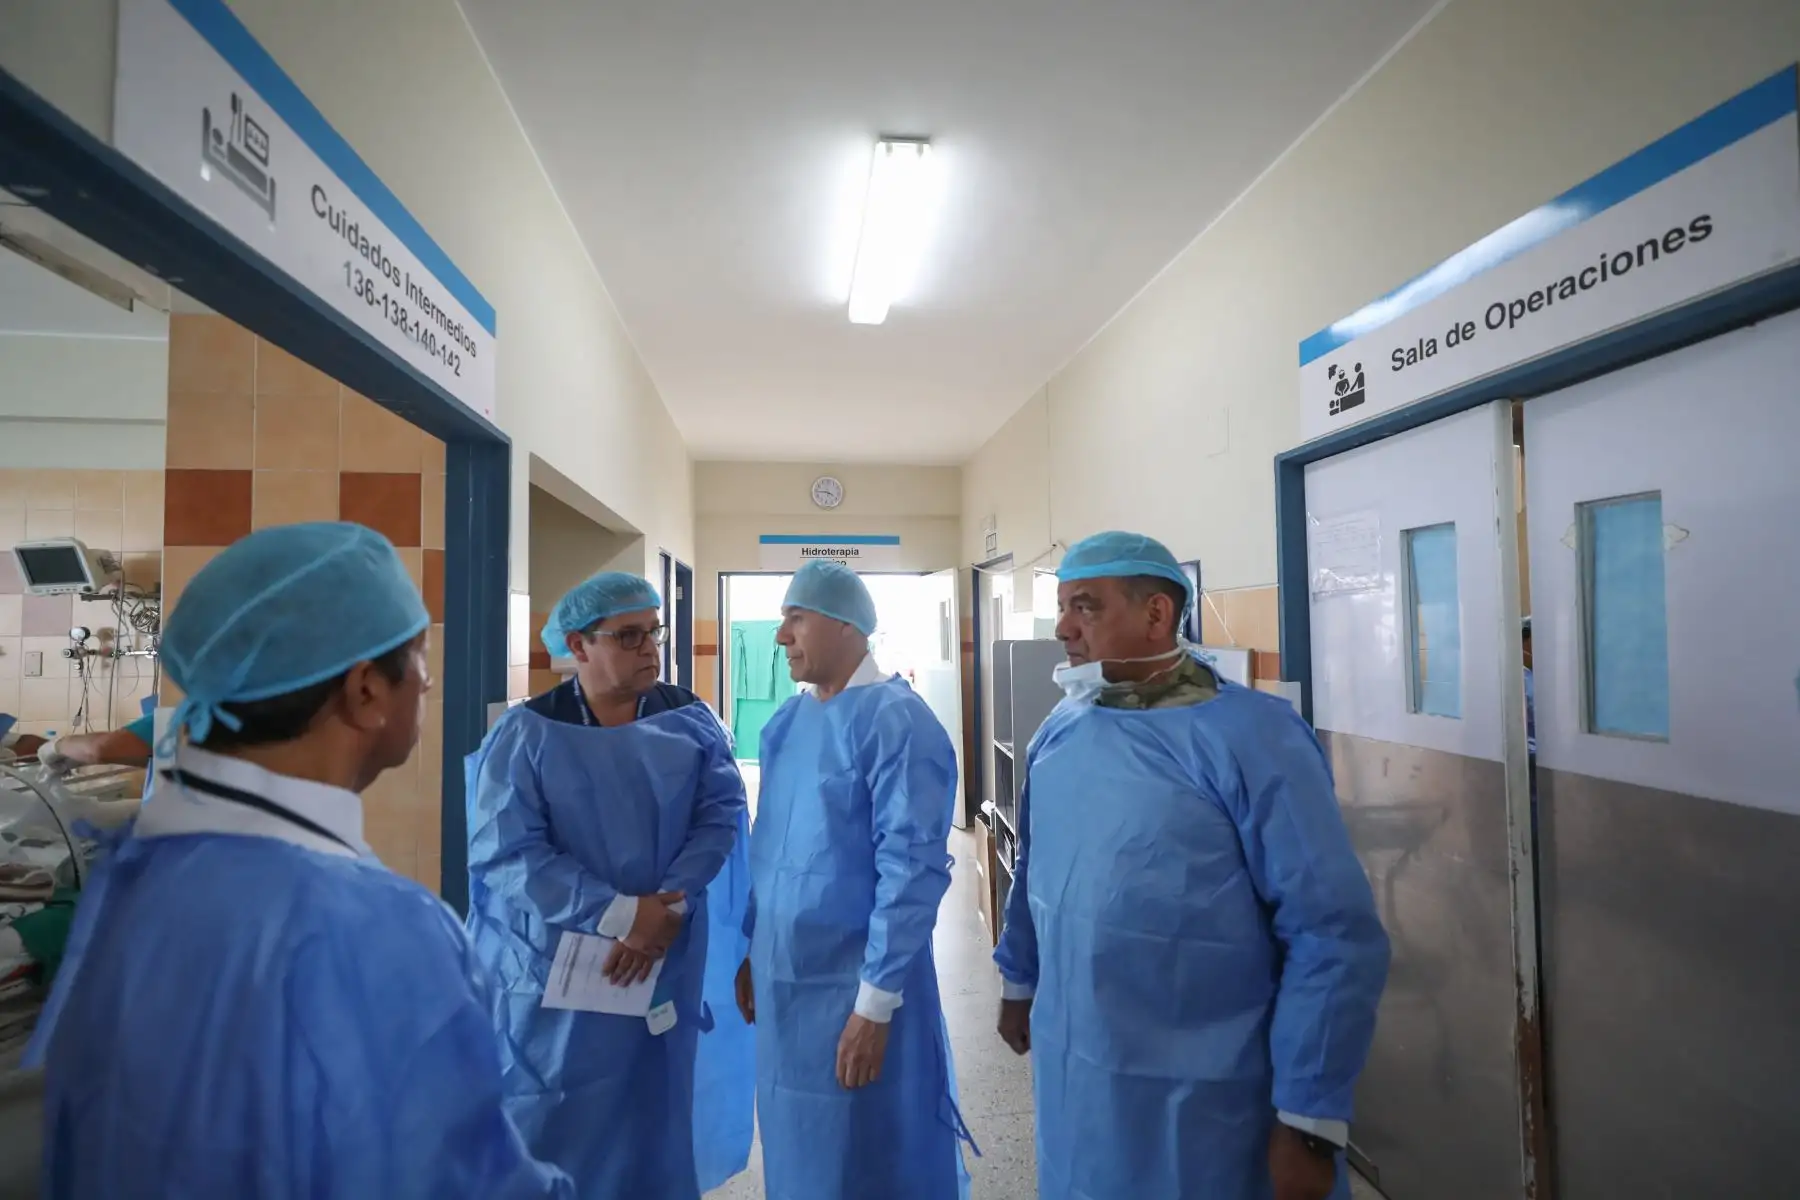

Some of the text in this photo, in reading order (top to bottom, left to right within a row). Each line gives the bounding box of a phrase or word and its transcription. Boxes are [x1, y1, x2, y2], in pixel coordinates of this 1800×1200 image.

[311, 184, 477, 358] Cuidados Intermedios
[342, 260, 461, 377] 136-138-140-142
[1391, 214, 1713, 372] Sala de Operaciones
[801, 547, 859, 558] Hidroterapia
